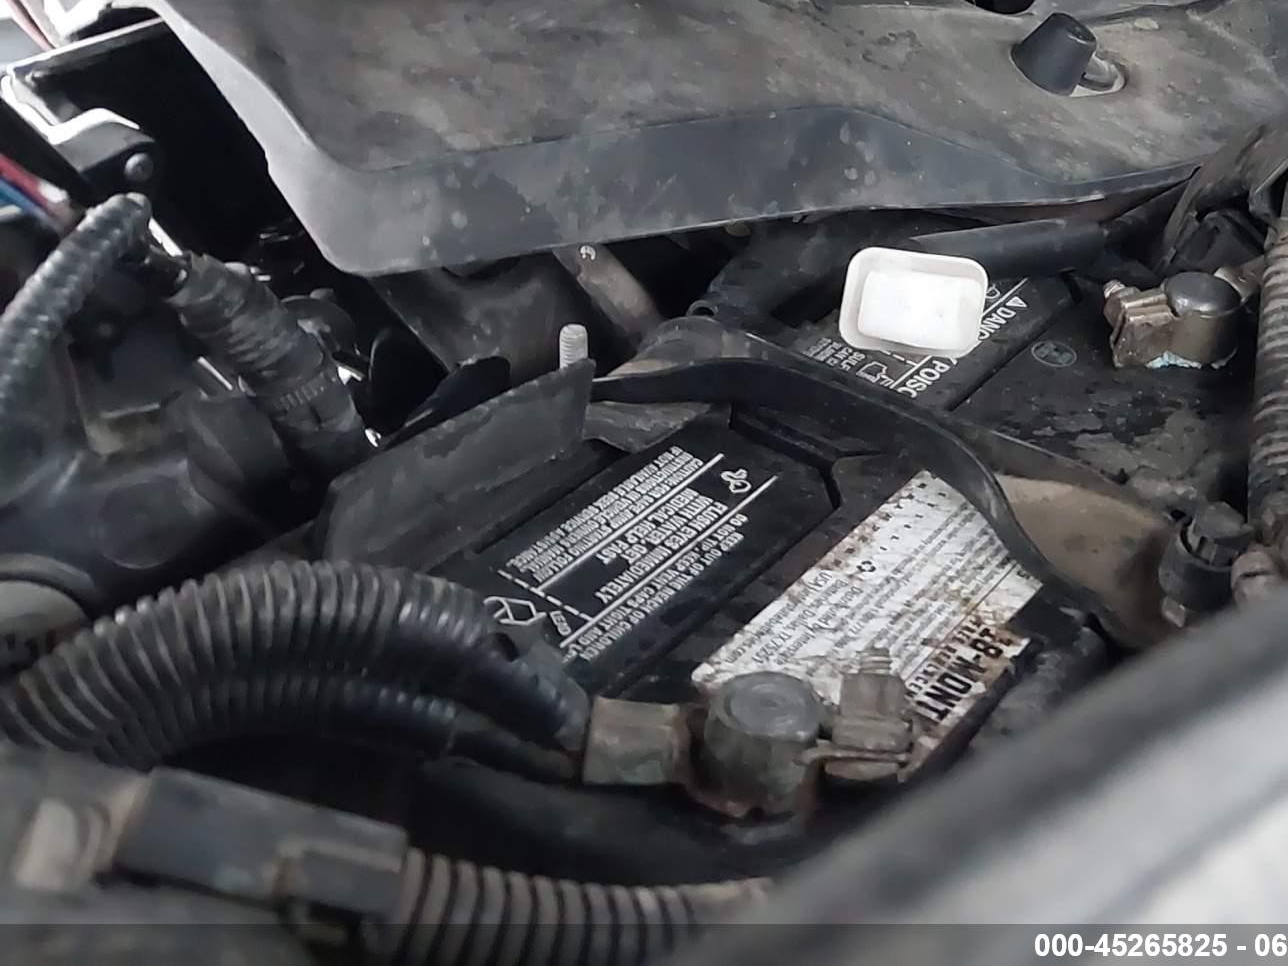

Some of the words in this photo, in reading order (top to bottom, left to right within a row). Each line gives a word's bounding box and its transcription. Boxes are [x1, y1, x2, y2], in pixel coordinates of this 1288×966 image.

[650, 452, 674, 467] NOT
[611, 464, 657, 495] AVAILABLE
[633, 453, 692, 493] INSTRUCTIONS
[591, 491, 618, 509] SEEK
[646, 483, 669, 497] FOR
[591, 497, 630, 523] VEHICLE
[626, 494, 653, 512] SAFE
[645, 488, 698, 525] MEDICAL
[678, 495, 712, 518] WITH
[557, 505, 599, 533] SERVICE
[604, 509, 633, 528] JUMP
[686, 502, 727, 530] FLUSH
[728, 513, 748, 527] DO
[566, 525, 611, 556] STARTING
[620, 520, 655, 543] HELP
[661, 526, 696, 549] EYES
[710, 524, 735, 540] NOT
[716, 532, 744, 551] KEEP
[593, 539, 629, 563] FAST
[617, 544, 647, 563] GET
[671, 551, 700, 571] KEEP
[699, 549, 723, 565] OUT
[531, 553, 573, 582] FOLLOW
[591, 545, 671, 603] IMMEDIATELY
[686, 563, 705, 575] OF
[648, 569, 677, 589] VENT
[668, 573, 693, 589] THE
[625, 586, 655, 607] CAPS
[638, 587, 675, 613] REACH
[596, 605, 630, 629] TIGHT
[624, 610, 645, 624] OF
[575, 627, 602, 645] AND
[577, 621, 631, 661] CHILDREN
[907, 626, 1011, 726] 18-MONT
